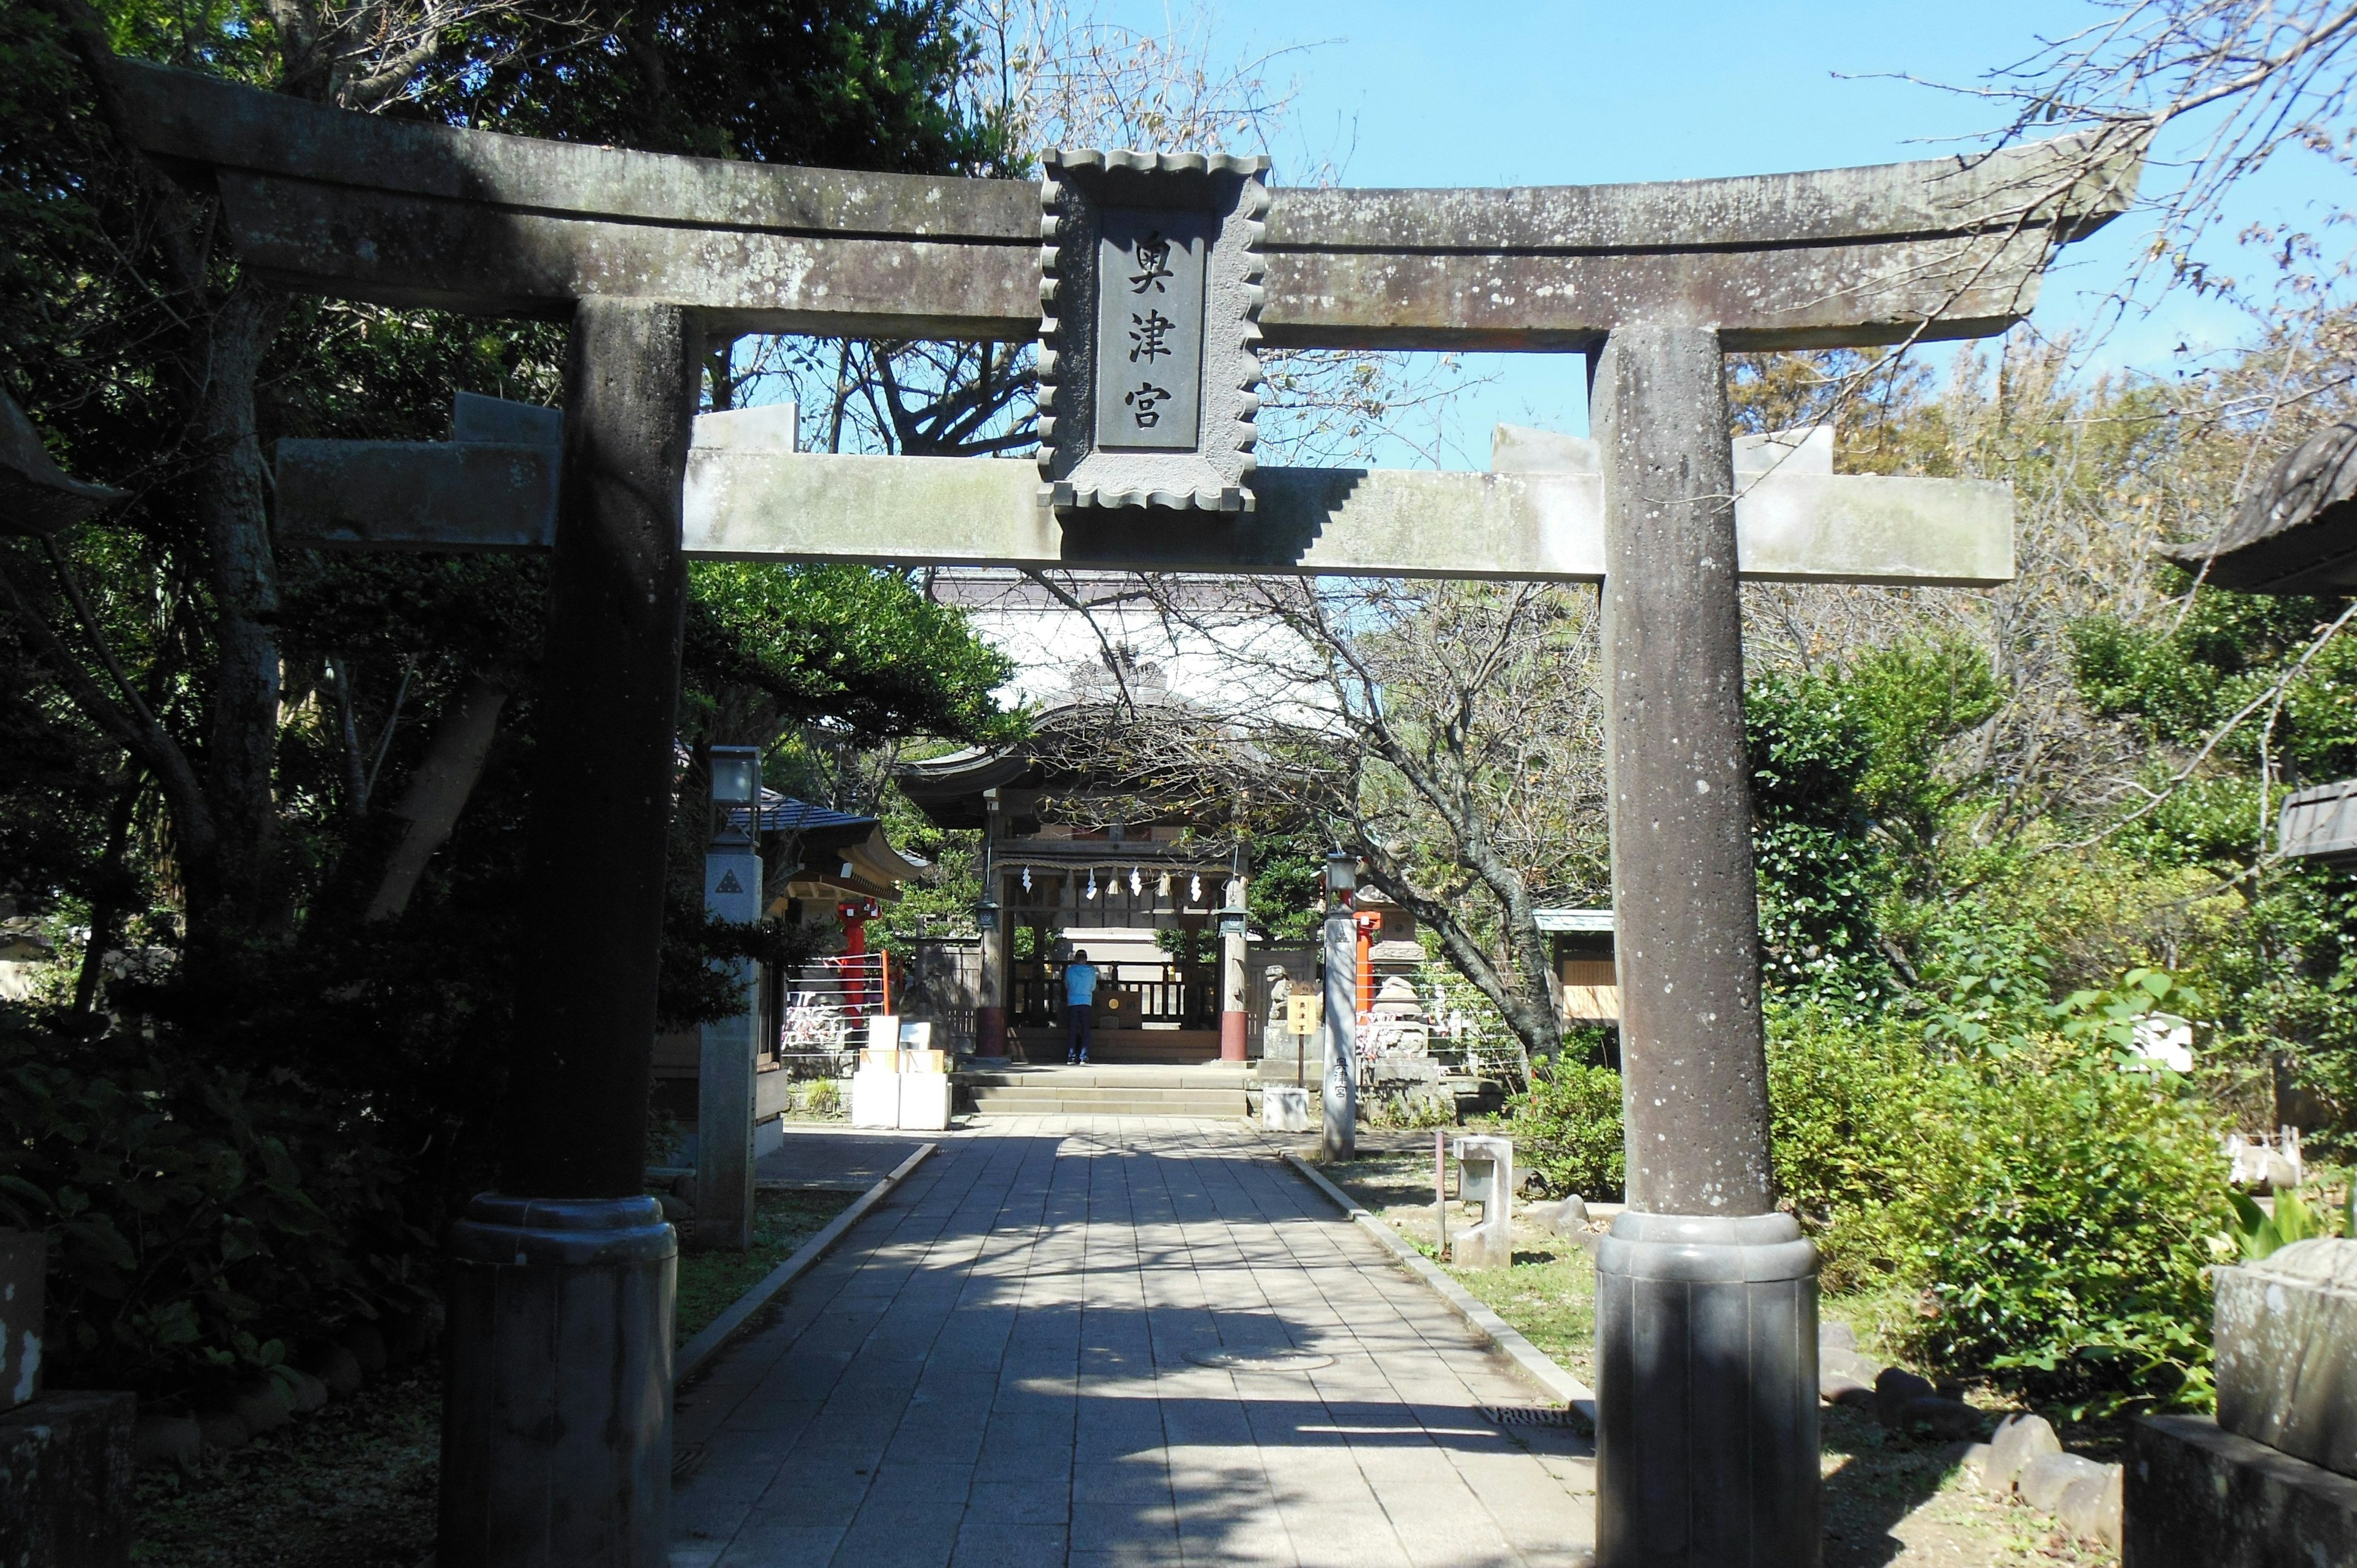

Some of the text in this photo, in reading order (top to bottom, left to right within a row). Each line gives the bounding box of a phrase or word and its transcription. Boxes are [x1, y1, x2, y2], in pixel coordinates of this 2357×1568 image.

[1124, 231, 1176, 430] 奥津宮
[1334, 1057, 1349, 1098] 奥津宮
